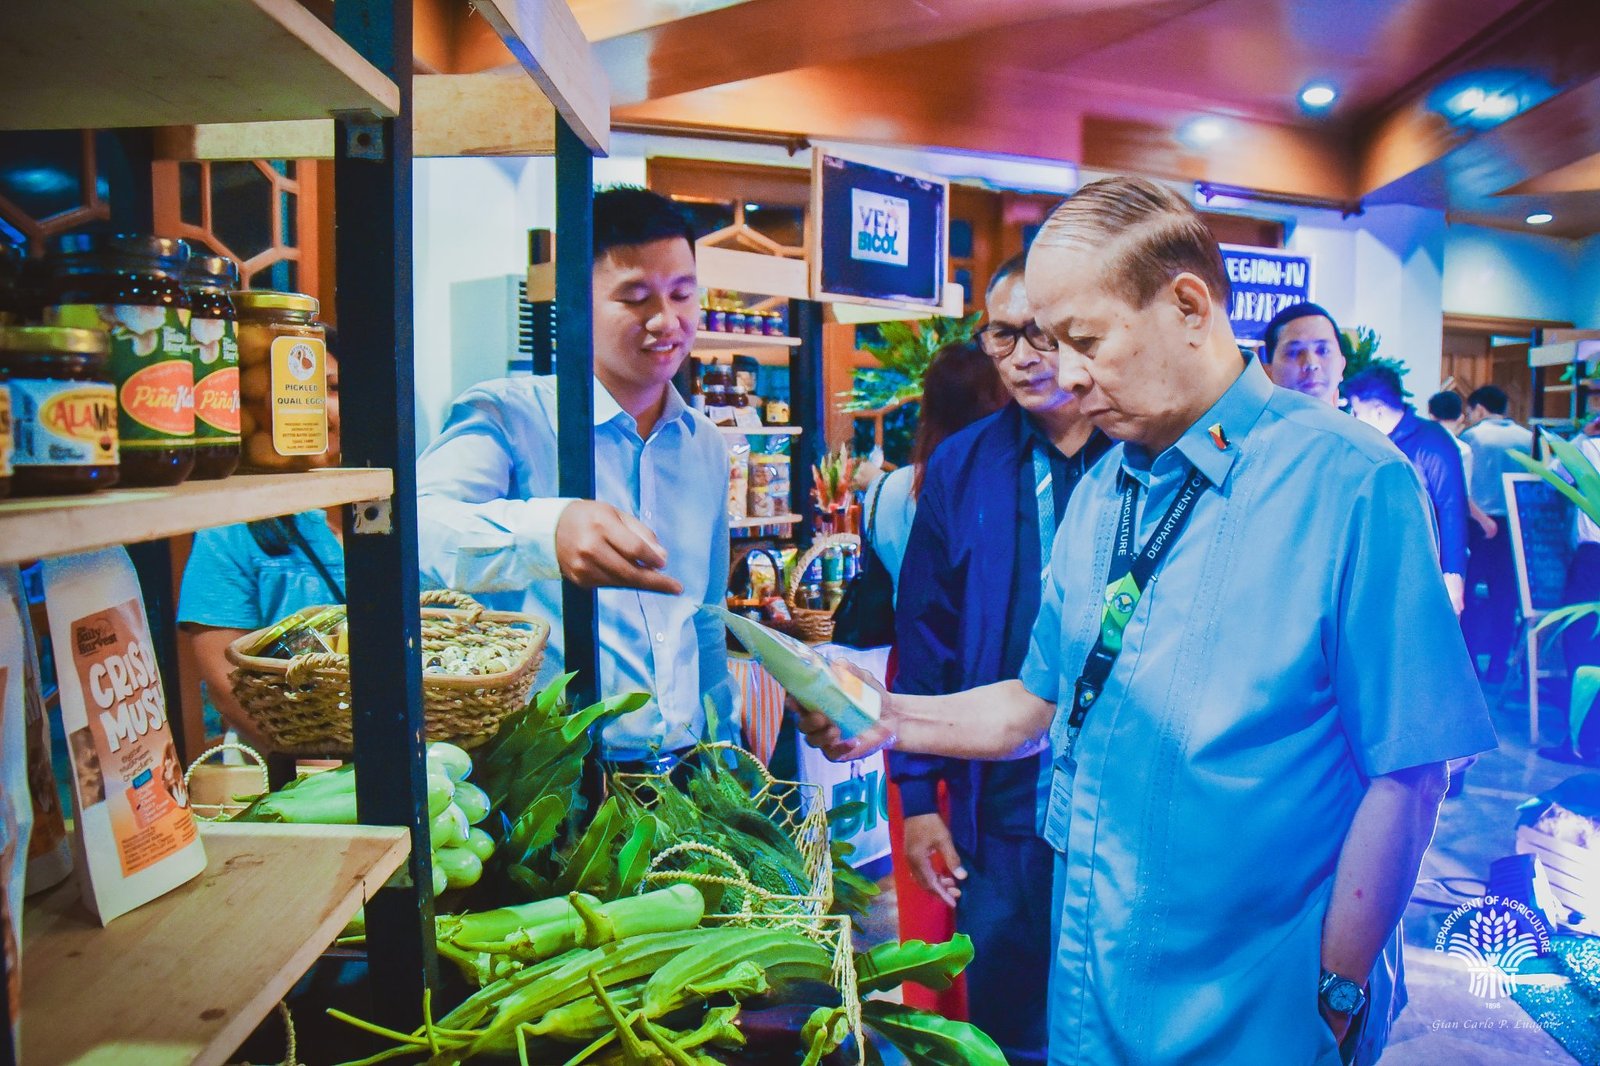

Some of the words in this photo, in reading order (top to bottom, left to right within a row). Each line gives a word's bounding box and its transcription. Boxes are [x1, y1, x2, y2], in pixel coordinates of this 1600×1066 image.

[858, 231, 899, 256] BICOL
[1225, 257, 1306, 288] EGION-IV
[1147, 487, 1195, 559] DEPARTMENT
